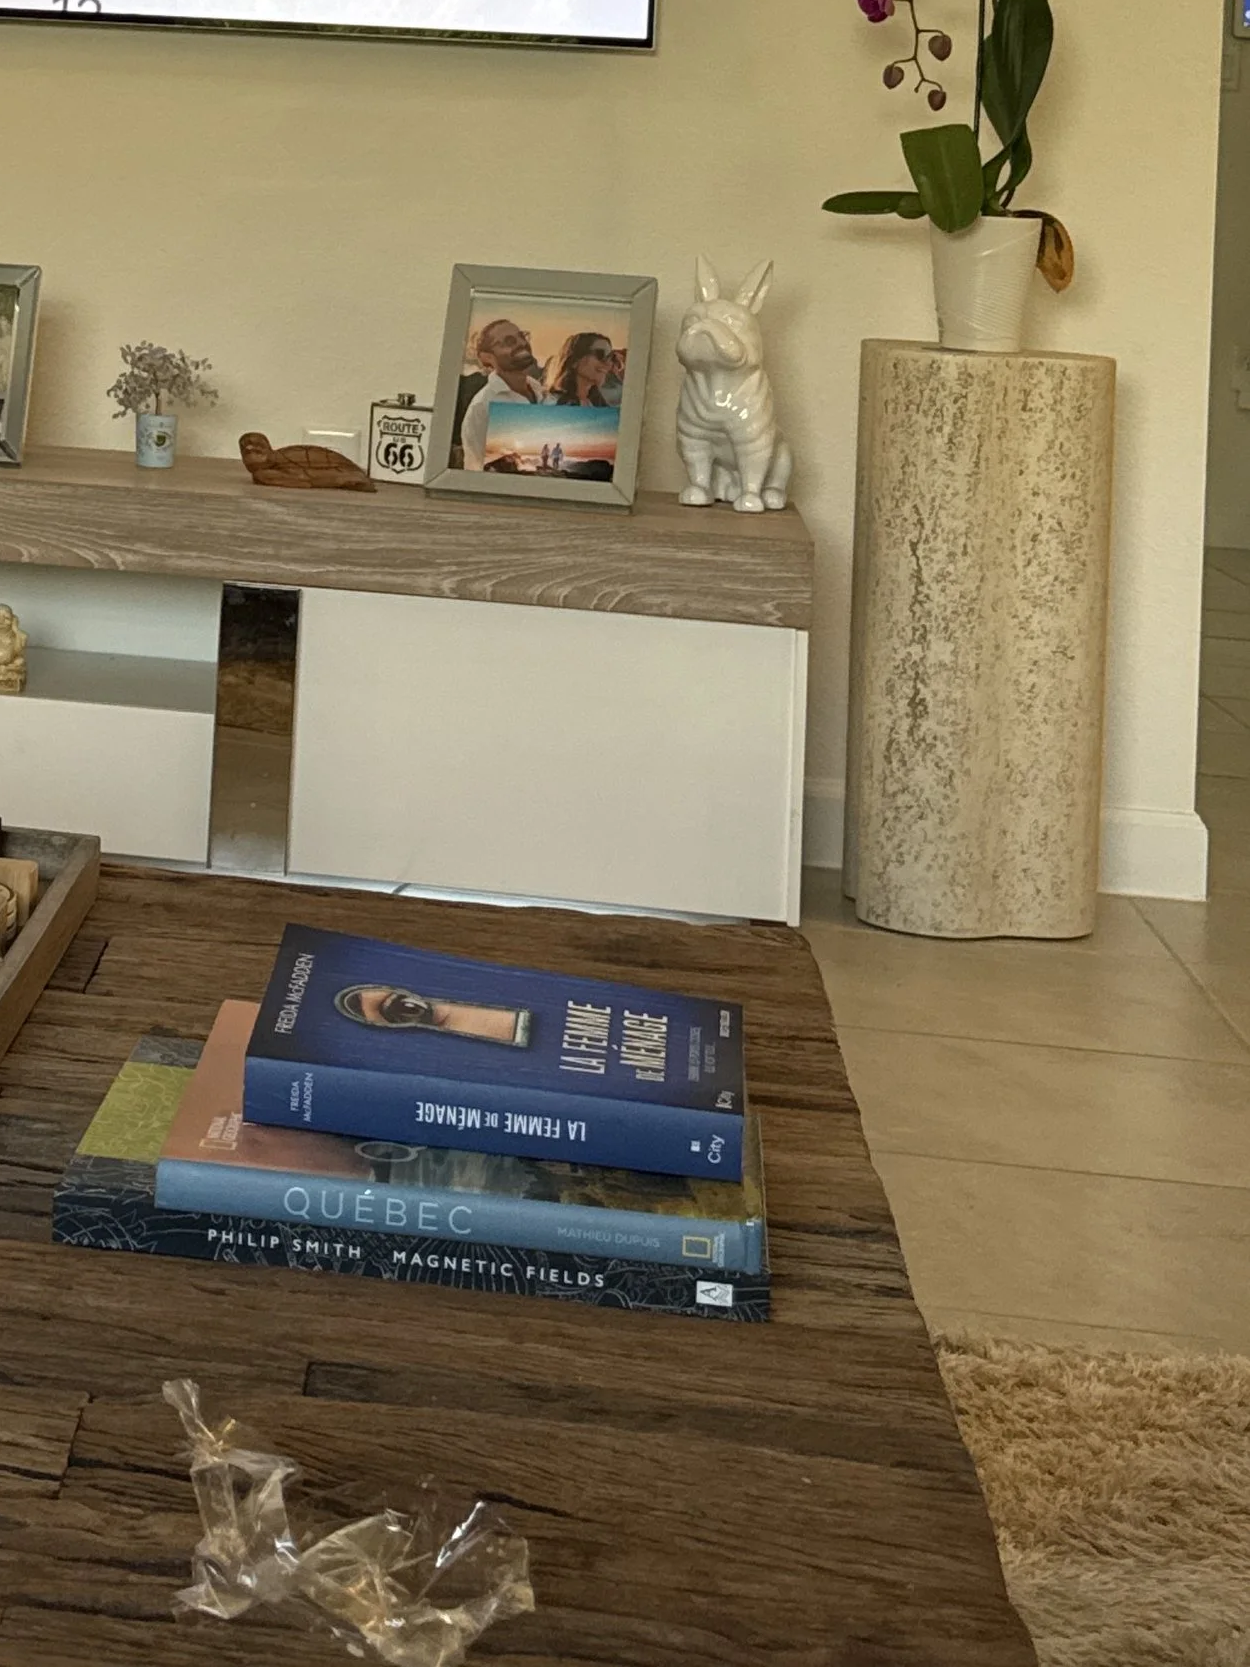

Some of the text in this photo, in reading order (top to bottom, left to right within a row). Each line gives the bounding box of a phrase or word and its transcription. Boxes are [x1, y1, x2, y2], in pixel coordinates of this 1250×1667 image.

[382, 422, 419, 434] ROUTE
[384, 443, 414, 468] 66
[274, 1004, 299, 1034] FREIDA
[559, 1000, 612, 1074] LA FEMME
[611, 1009, 669, 1082] DE MÉNAGE
[290, 1080, 300, 1112] FREIDA
[415, 1101, 586, 1142] LA FEMME DE MÉNAGE
[707, 1134, 726, 1164] City
[284, 1187, 472, 1234] QUÉBEC
[557, 1227, 661, 1248] MATHIEU DUPUIS
[208, 1229, 605, 1288] PHILIP SMITH MAGNETIC FIELDS
